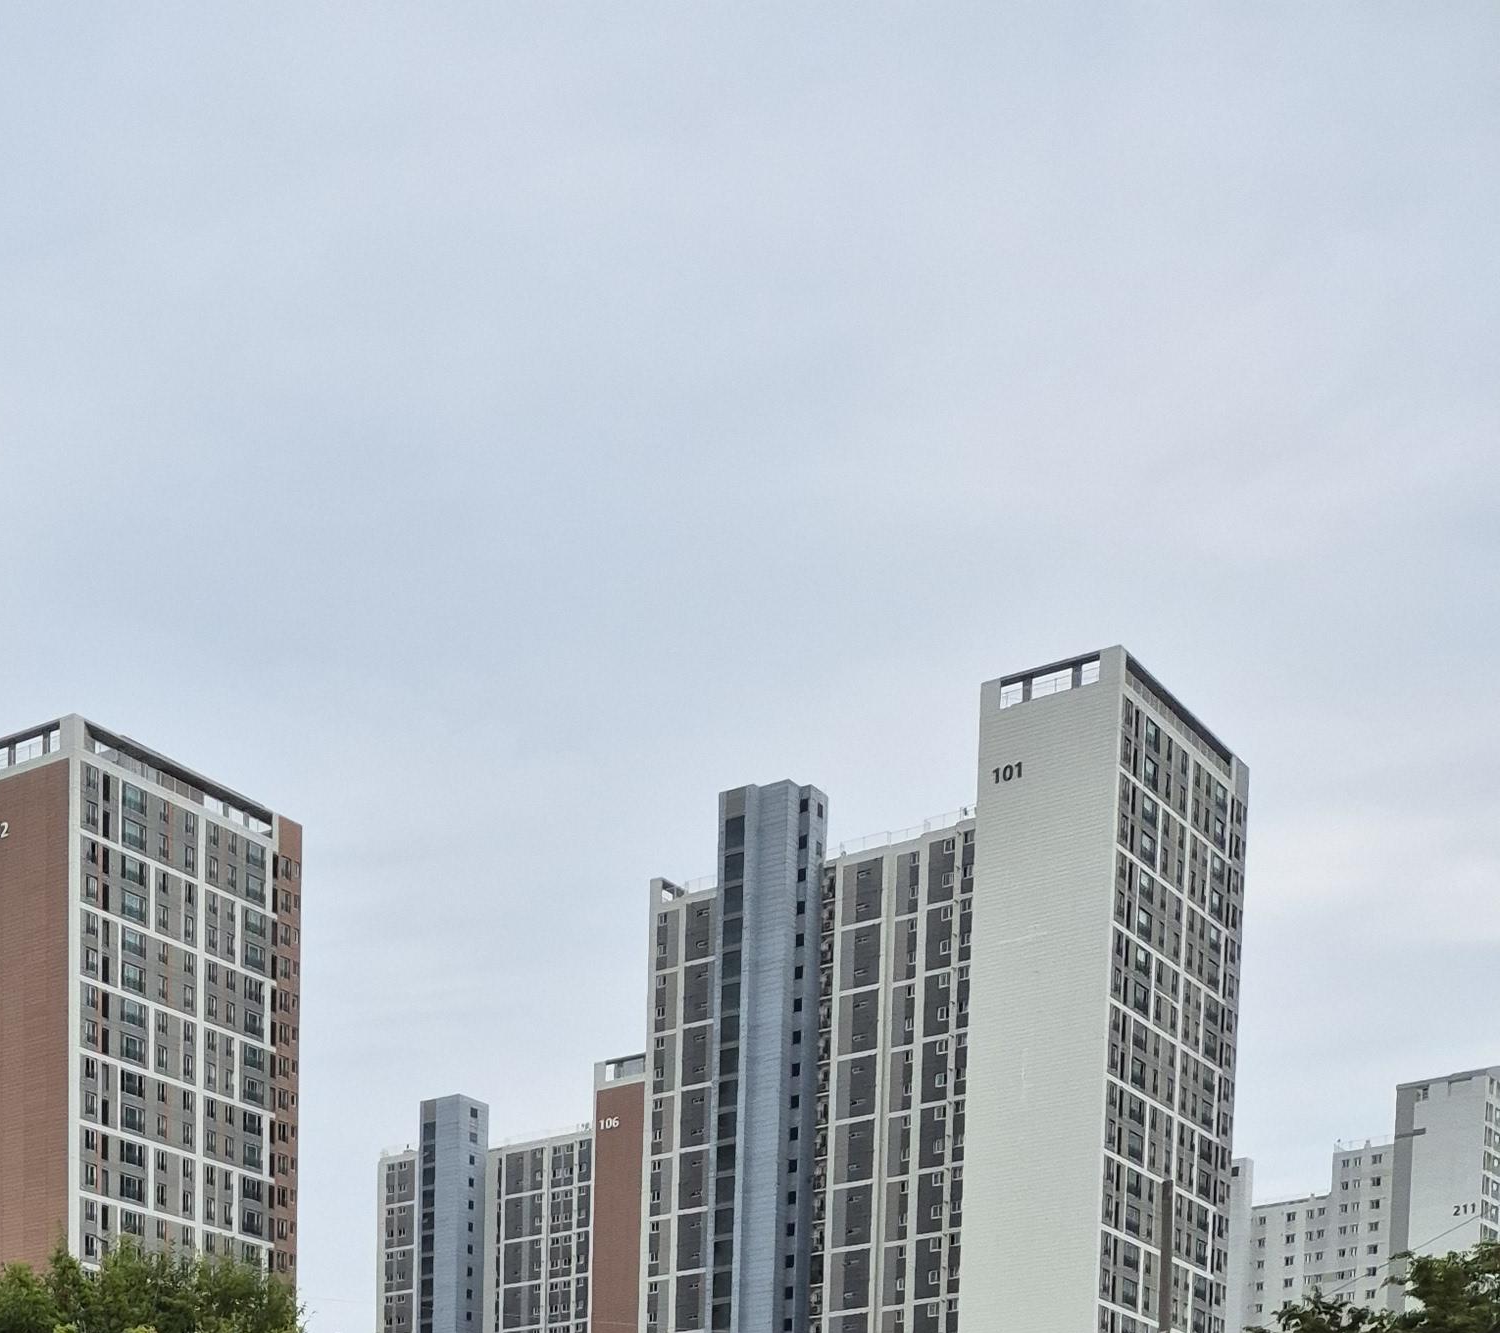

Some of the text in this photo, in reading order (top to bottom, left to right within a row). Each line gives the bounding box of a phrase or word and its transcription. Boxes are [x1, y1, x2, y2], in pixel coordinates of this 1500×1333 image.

[993, 761, 1022, 784] 101
[599, 1116, 619, 1130] 106
[1453, 1203, 1475, 1216] 211
